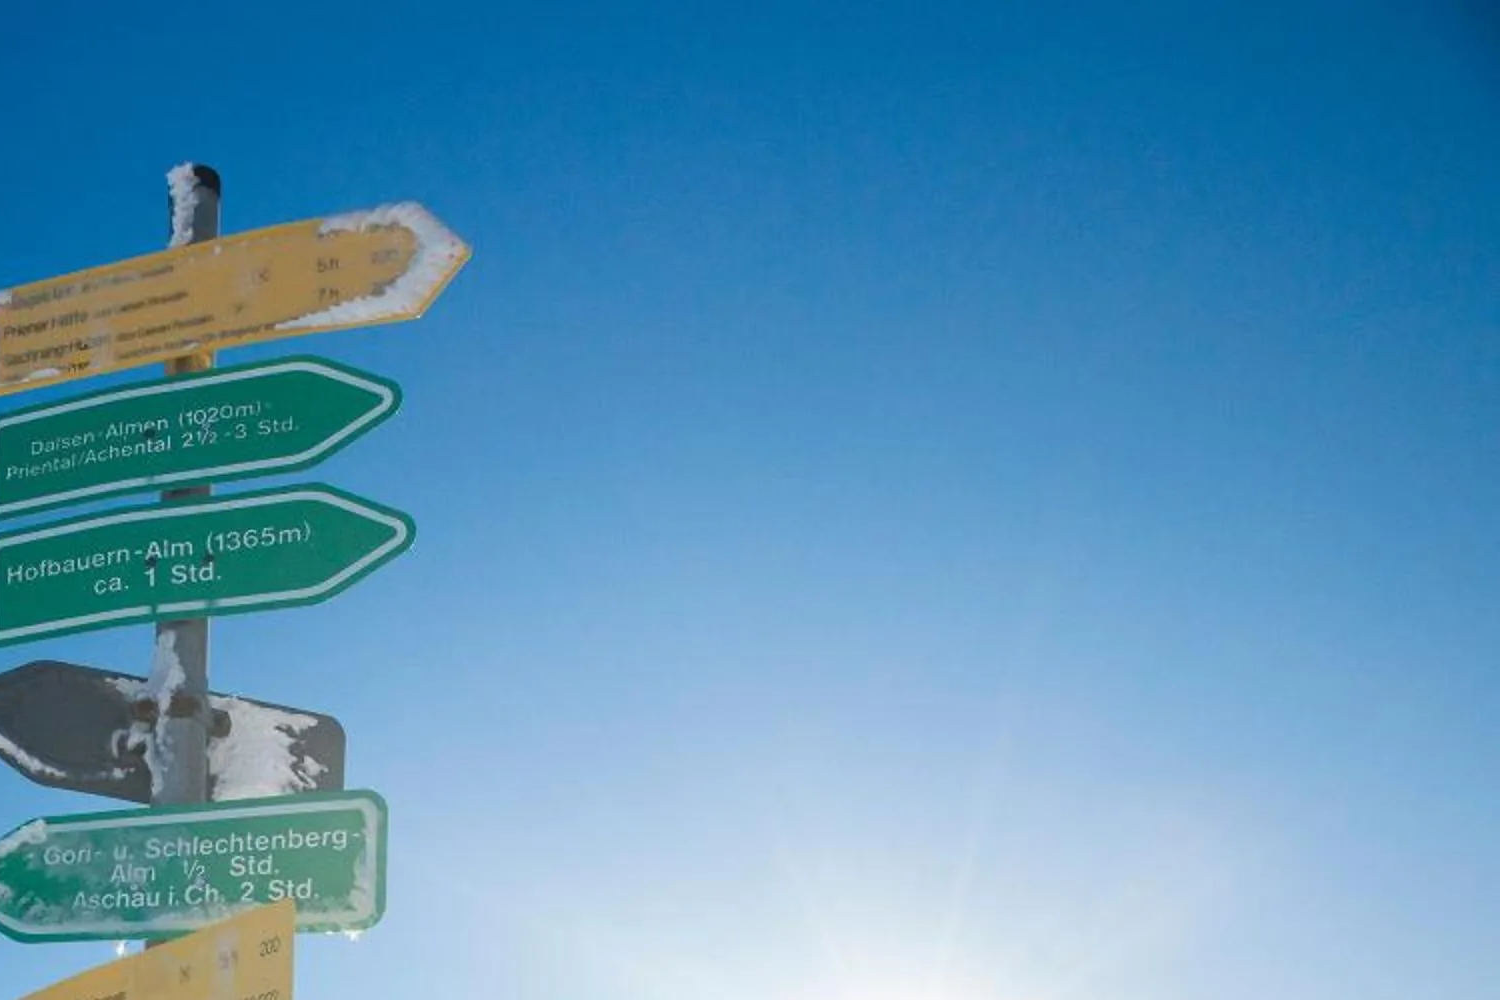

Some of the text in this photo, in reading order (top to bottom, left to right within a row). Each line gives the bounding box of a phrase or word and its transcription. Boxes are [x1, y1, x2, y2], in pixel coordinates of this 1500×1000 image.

[179, 401, 261, 428] (1020m)
[5, 435, 172, 480] Priental/Achental
[258, 415, 300, 435] Std.
[7, 520, 311, 584] Hofbauern-Alm (1365m)
[93, 561, 222, 595] ca. 1 Std.
[145, 828, 360, 858] Schlechtenberg-
[110, 863, 156, 884] Alm
[229, 854, 280, 877] Std.
[72, 888, 160, 909] Aschau
[240, 881, 255, 901] 2
[268, 878, 320, 901] Std.
